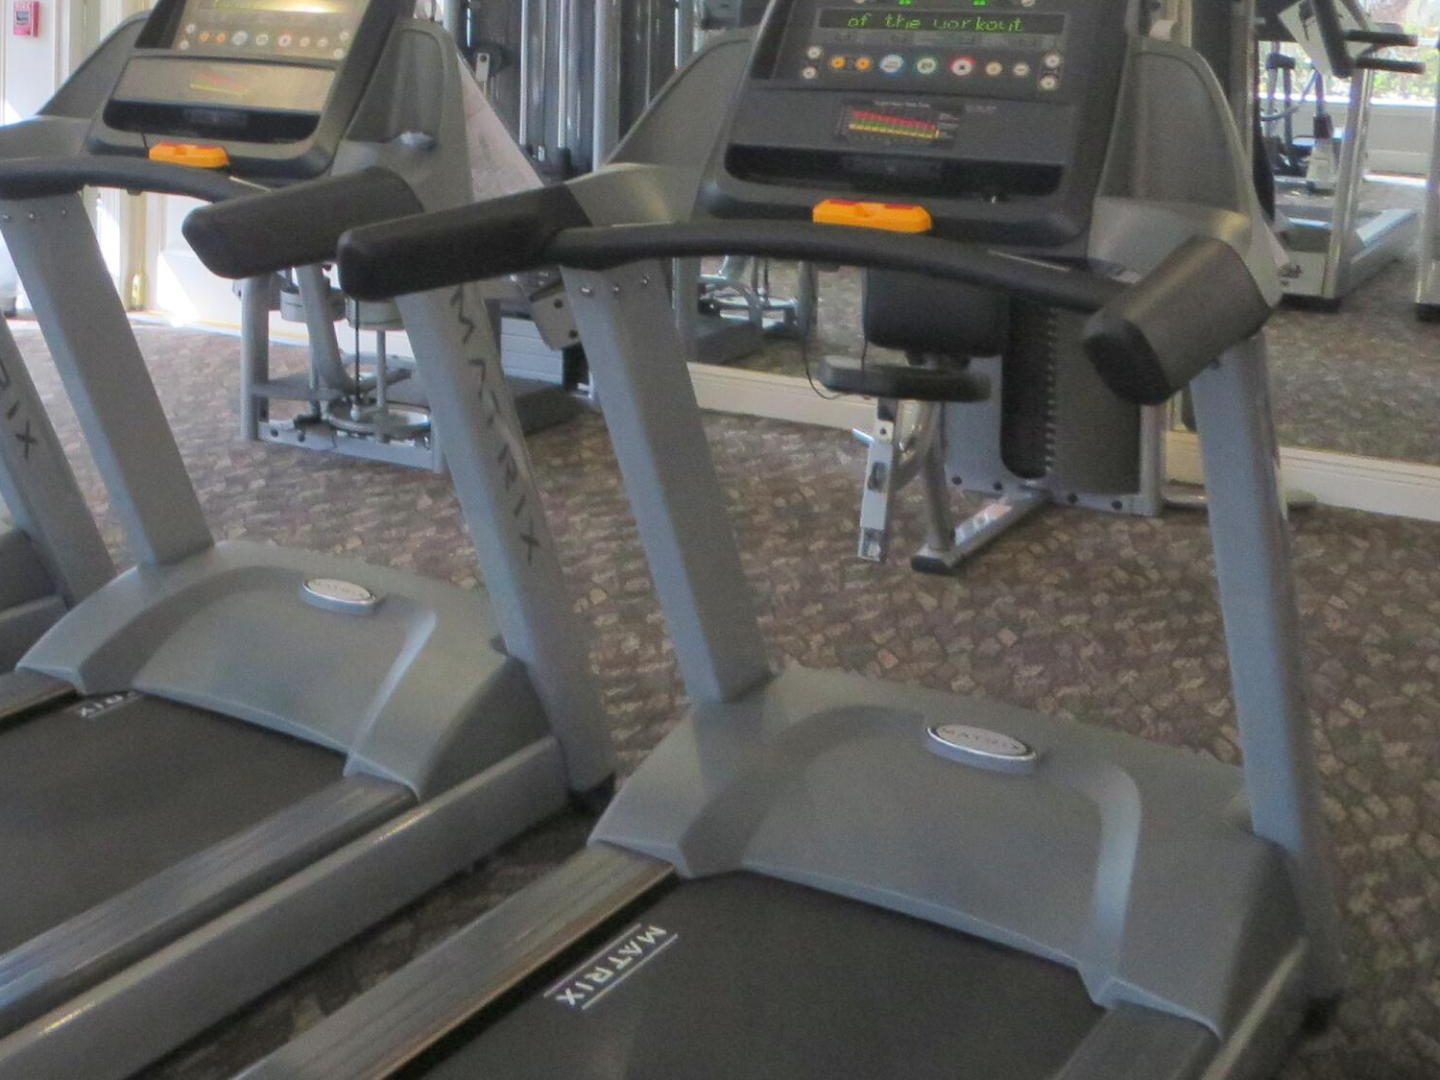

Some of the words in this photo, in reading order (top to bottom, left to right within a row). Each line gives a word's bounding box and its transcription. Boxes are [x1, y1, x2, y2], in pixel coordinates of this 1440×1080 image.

[848, 13, 871, 27] of
[885, 14, 921, 29] the
[556, 925, 667, 1006] MATRIX
